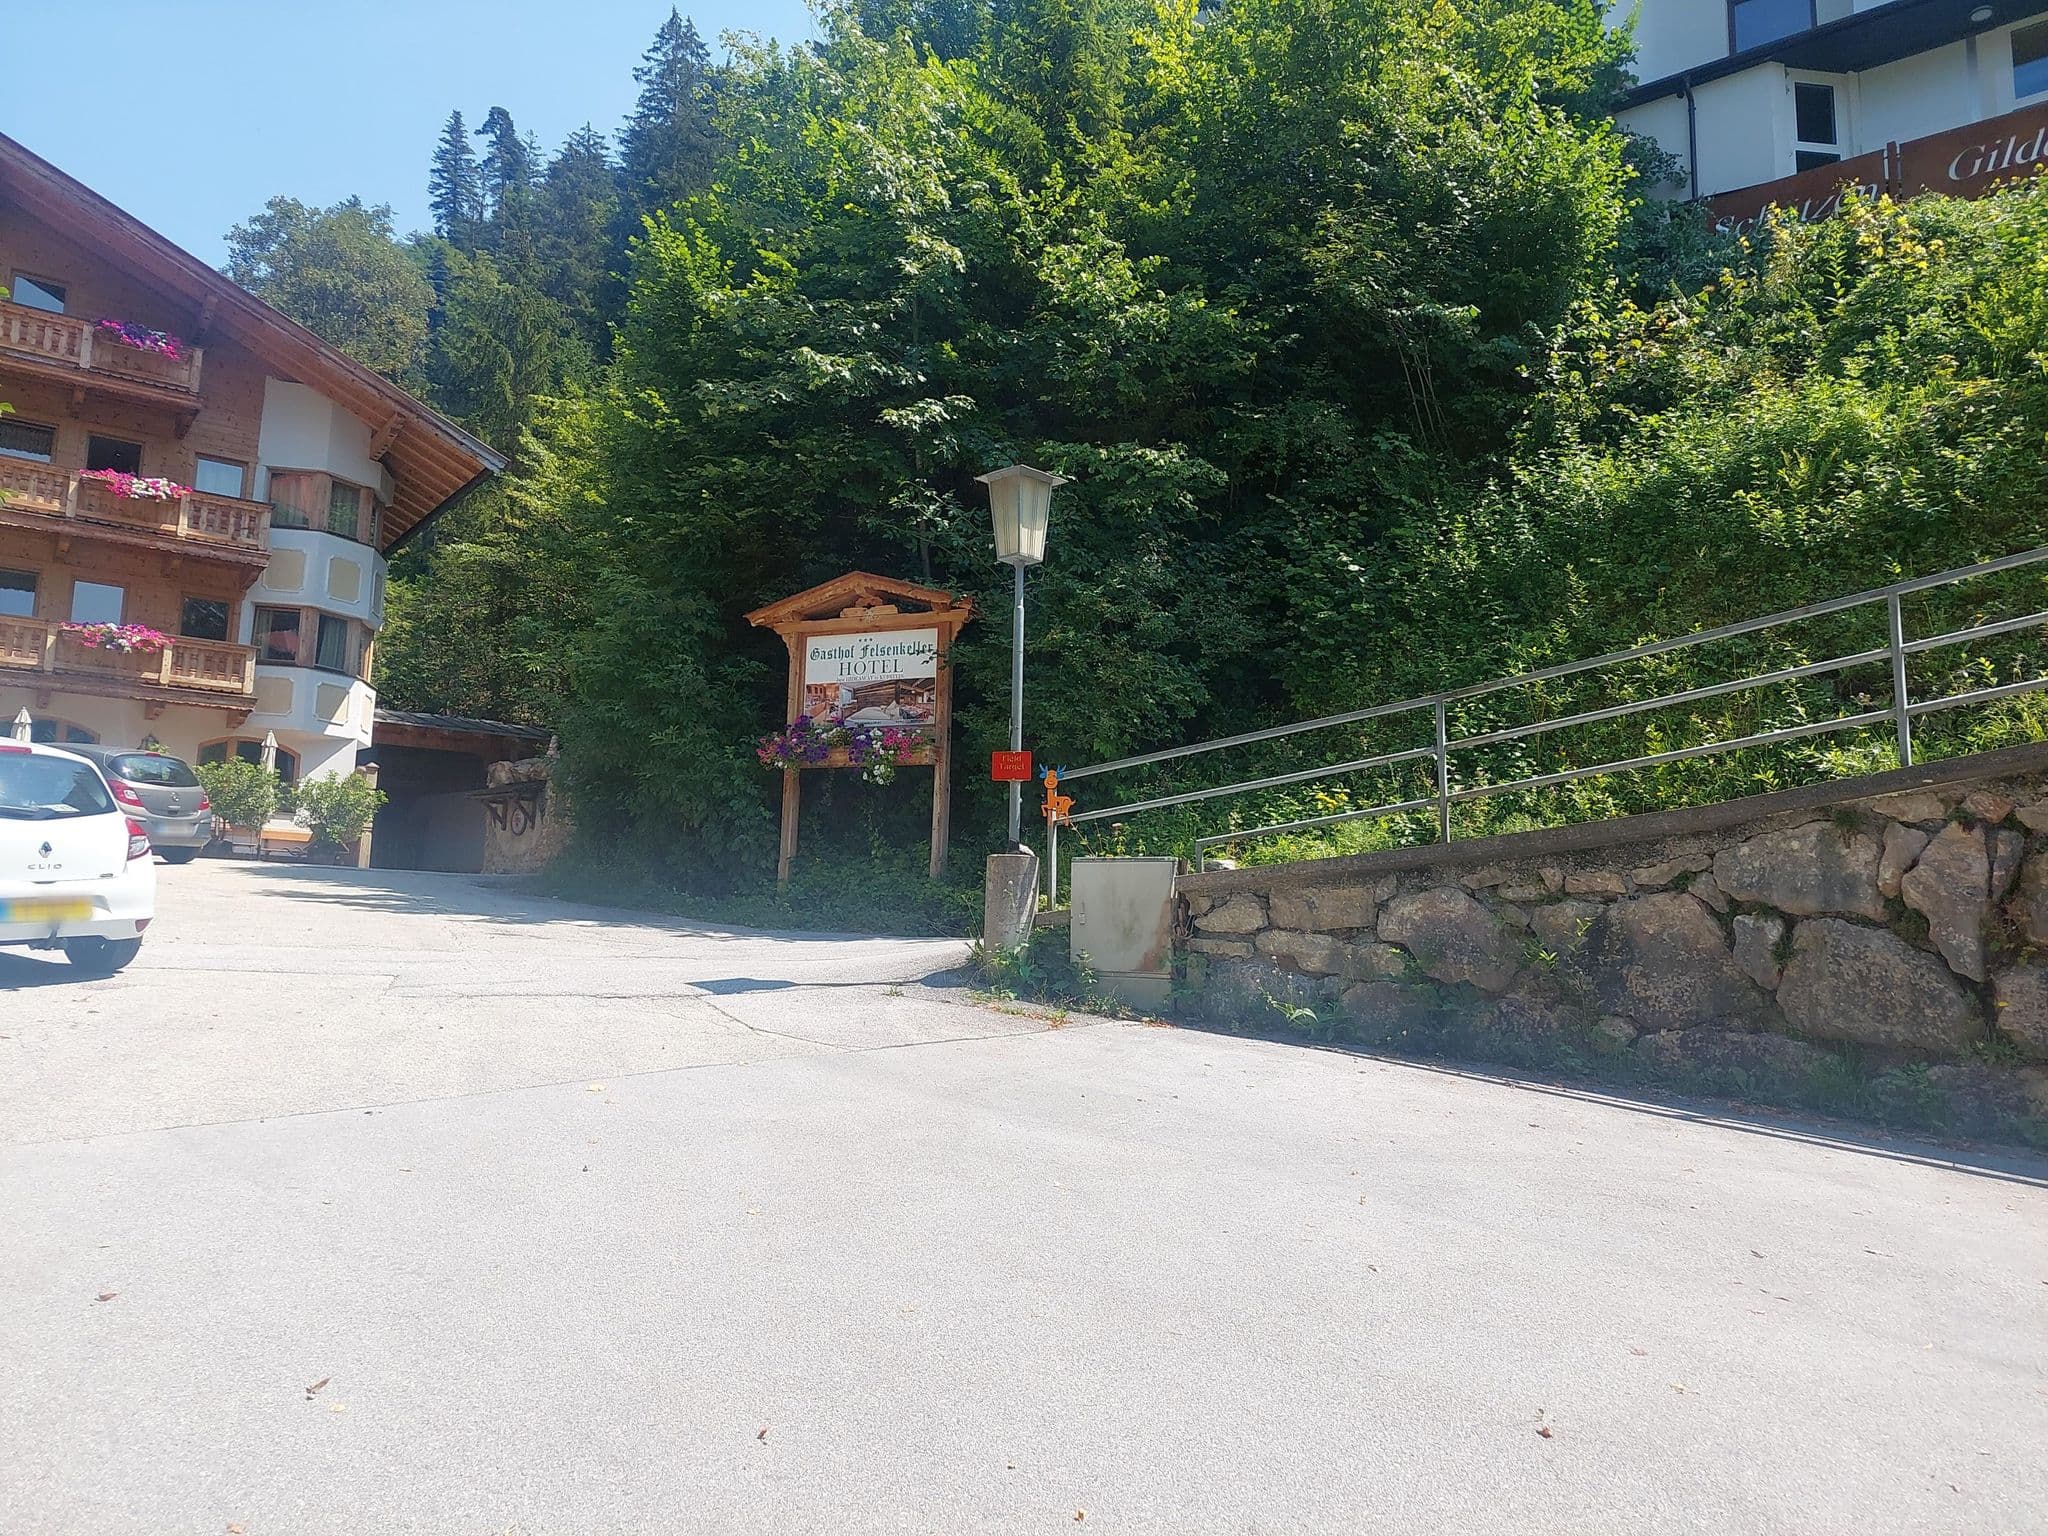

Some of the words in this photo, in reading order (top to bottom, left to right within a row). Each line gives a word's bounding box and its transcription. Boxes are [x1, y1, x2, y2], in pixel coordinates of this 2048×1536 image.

[810, 645, 855, 661] Gasthof
[860, 641, 934, 659] Felsenkeller
[839, 658, 904, 676] HOTEL
